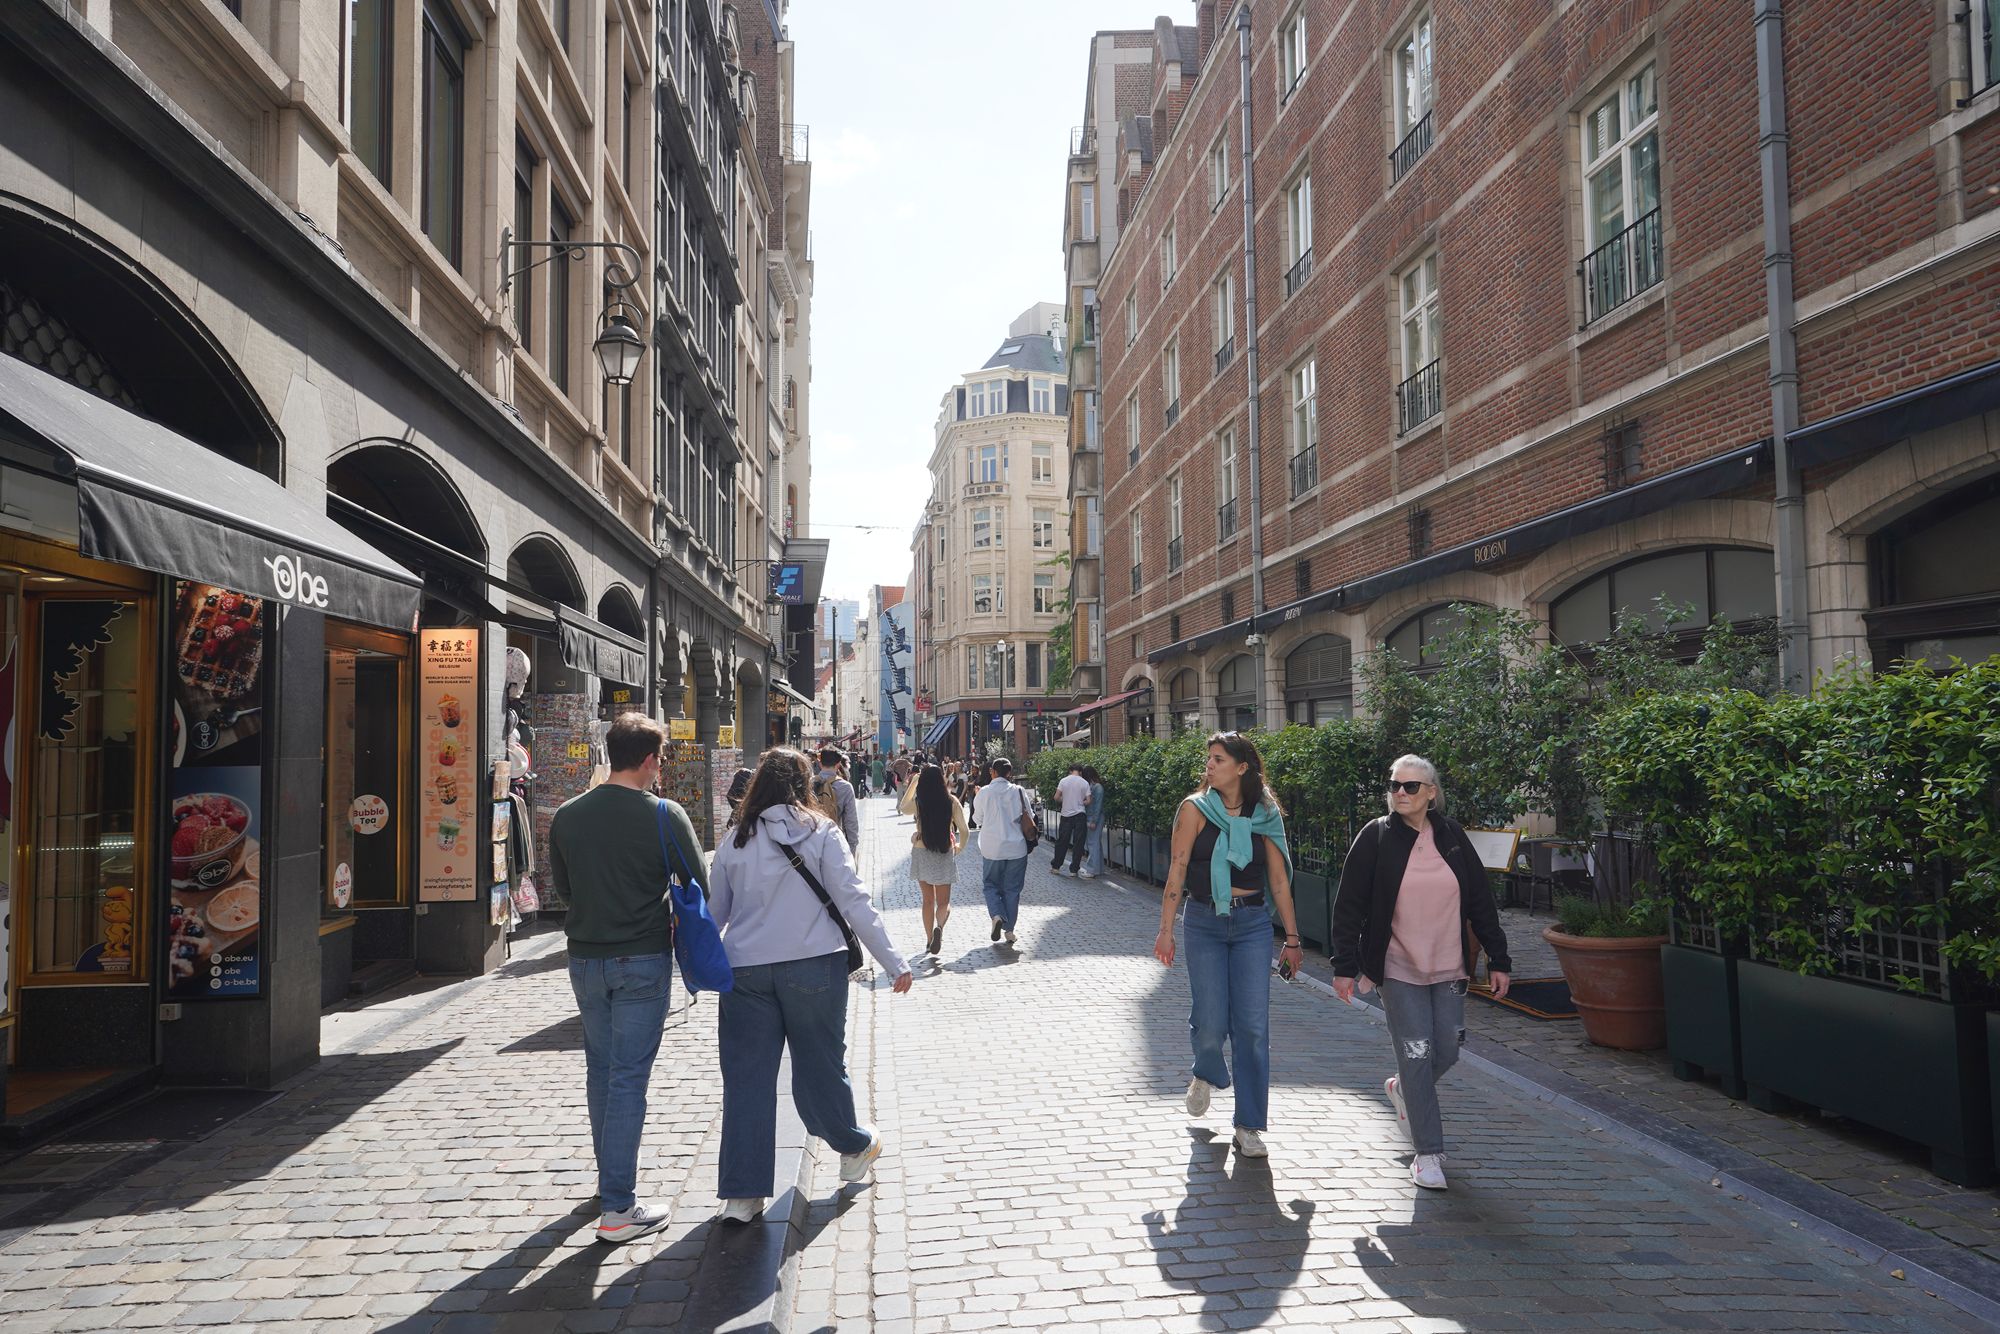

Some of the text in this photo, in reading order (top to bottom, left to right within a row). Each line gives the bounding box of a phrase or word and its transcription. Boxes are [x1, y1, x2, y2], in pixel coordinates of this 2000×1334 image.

[427, 639, 465, 653] 幸福堂
[353, 808, 385, 818] Bubble
[360, 817, 377, 825] Tea
[224, 967, 241, 975] obe
